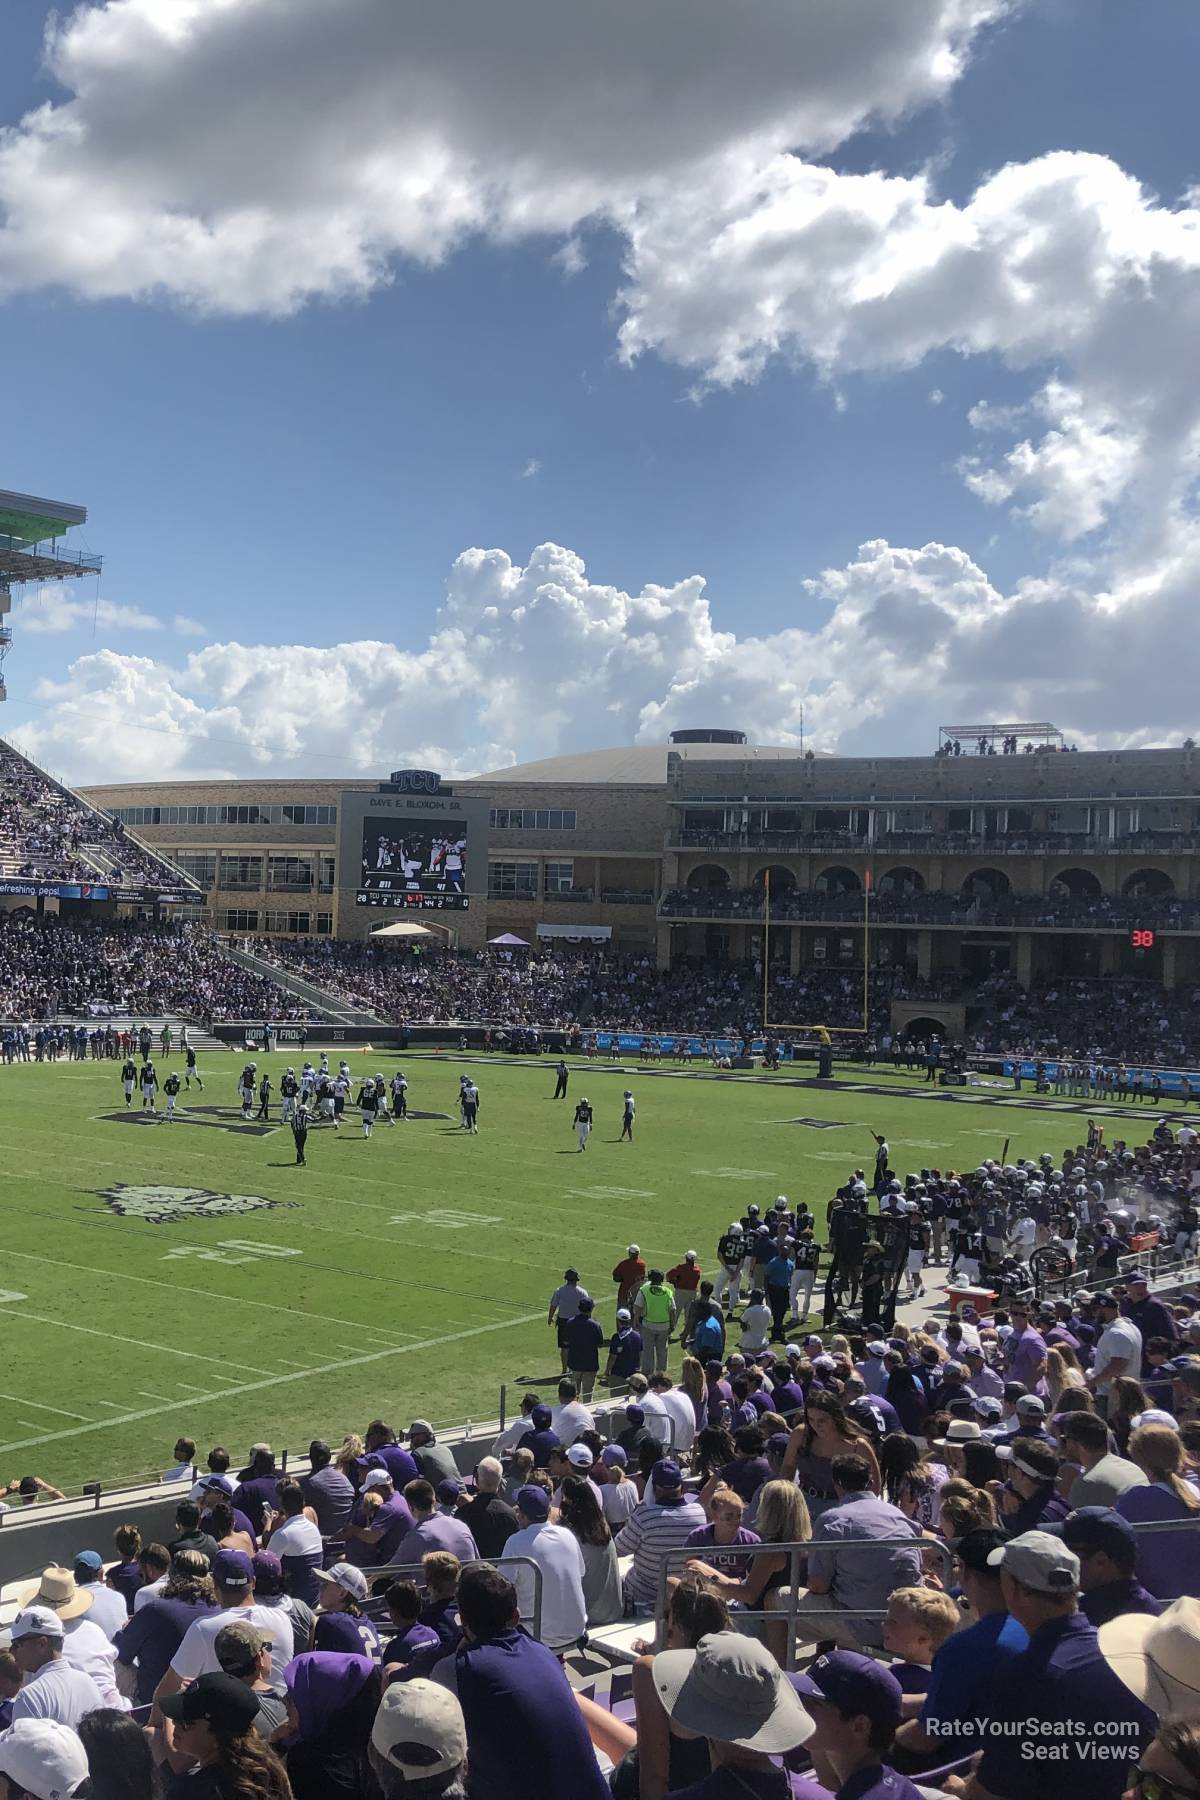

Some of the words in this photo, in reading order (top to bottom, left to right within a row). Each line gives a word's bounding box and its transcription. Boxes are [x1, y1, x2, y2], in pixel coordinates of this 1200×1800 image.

[394, 771, 440, 794] TCU
[370, 798, 392, 807] DAVE
[357, 894, 367, 903] 28
[1131, 930, 1153, 947] 38
[966, 1235, 982, 1251] 14
[168, 1239, 304, 1265] 20
[797, 1246, 816, 1263] 43
[869, 1405, 886, 1432] 5
